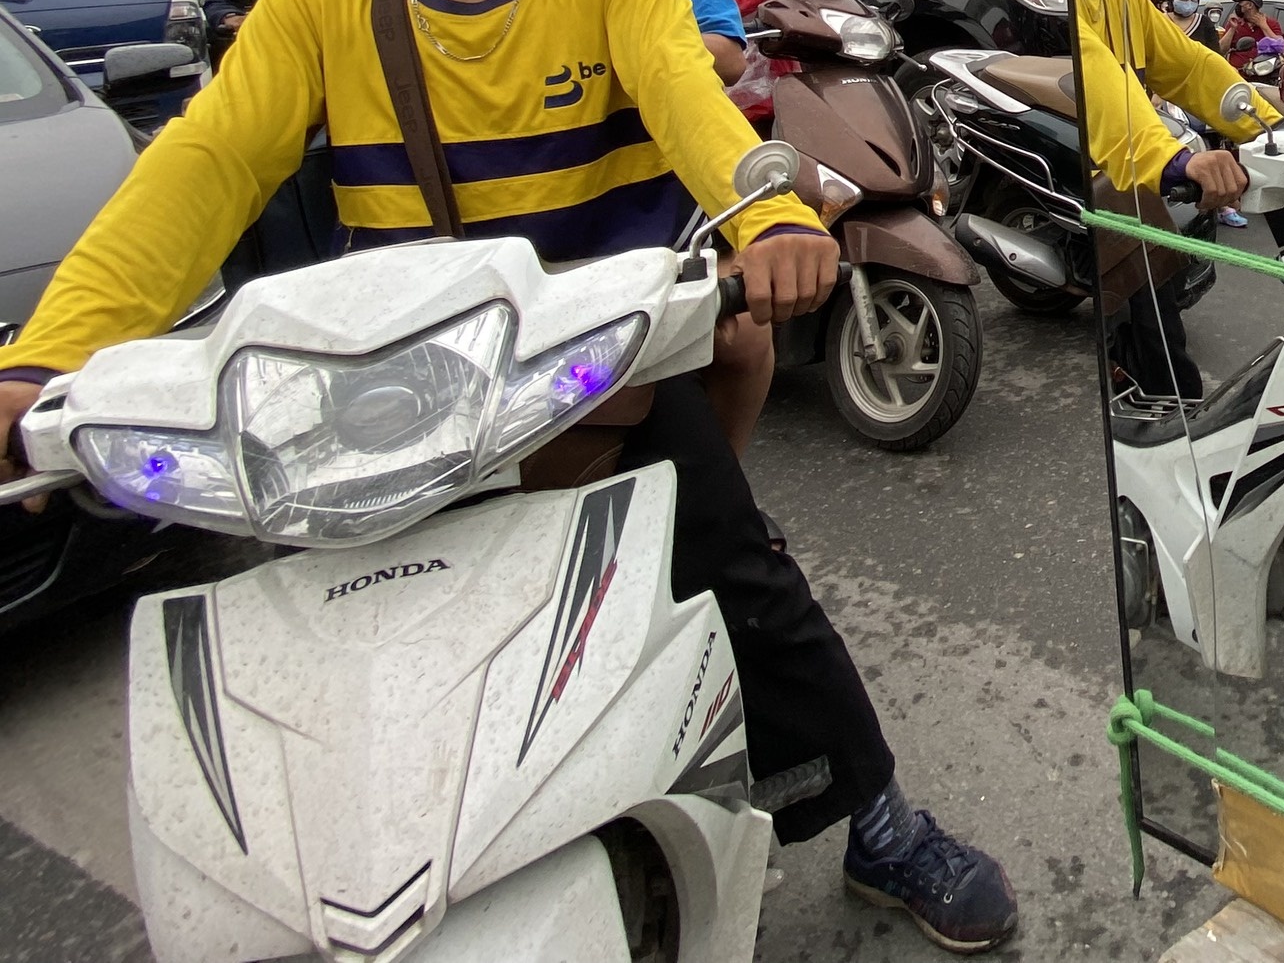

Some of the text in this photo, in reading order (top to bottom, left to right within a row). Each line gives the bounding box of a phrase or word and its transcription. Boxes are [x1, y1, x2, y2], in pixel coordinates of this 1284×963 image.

[578, 61, 607, 80] be
[394, 82, 418, 134] Jeep
[324, 558, 452, 604] HONDA
[672, 631, 718, 762] HONDA
[698, 668, 735, 743] 110
